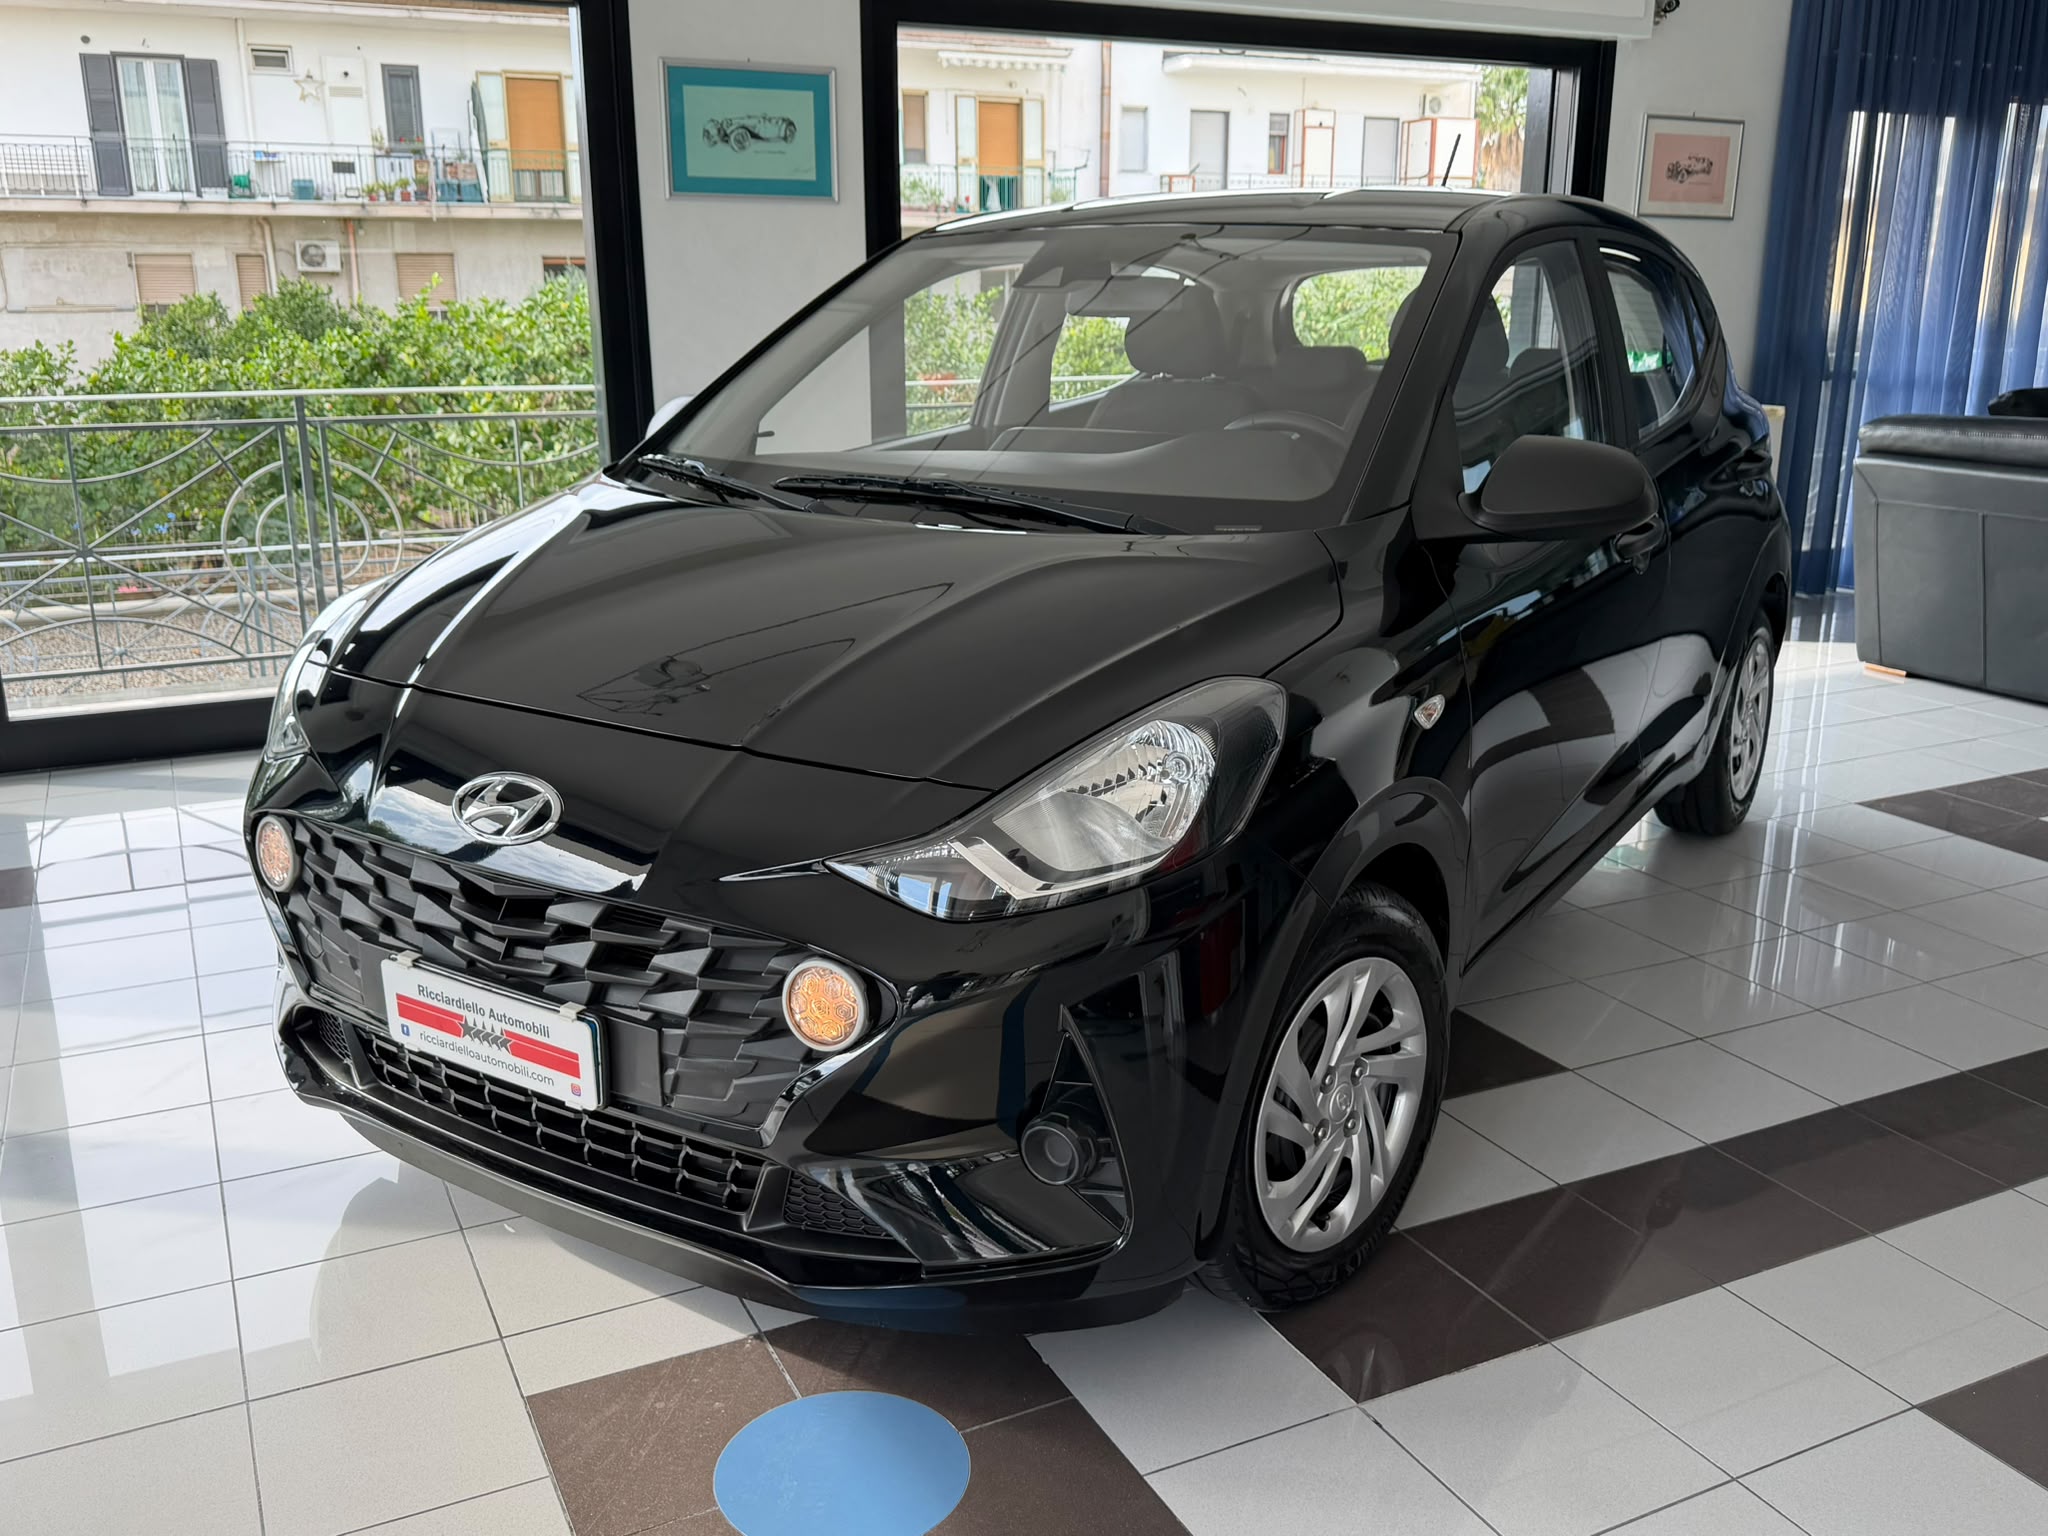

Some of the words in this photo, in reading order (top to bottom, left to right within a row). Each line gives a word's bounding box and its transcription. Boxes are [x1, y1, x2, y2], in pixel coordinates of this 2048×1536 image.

[417, 984, 486, 1017] Ricciardiello
[488, 1008, 551, 1039] Automobili
[419, 1030, 555, 1087] ricciardielloautomobili.com
